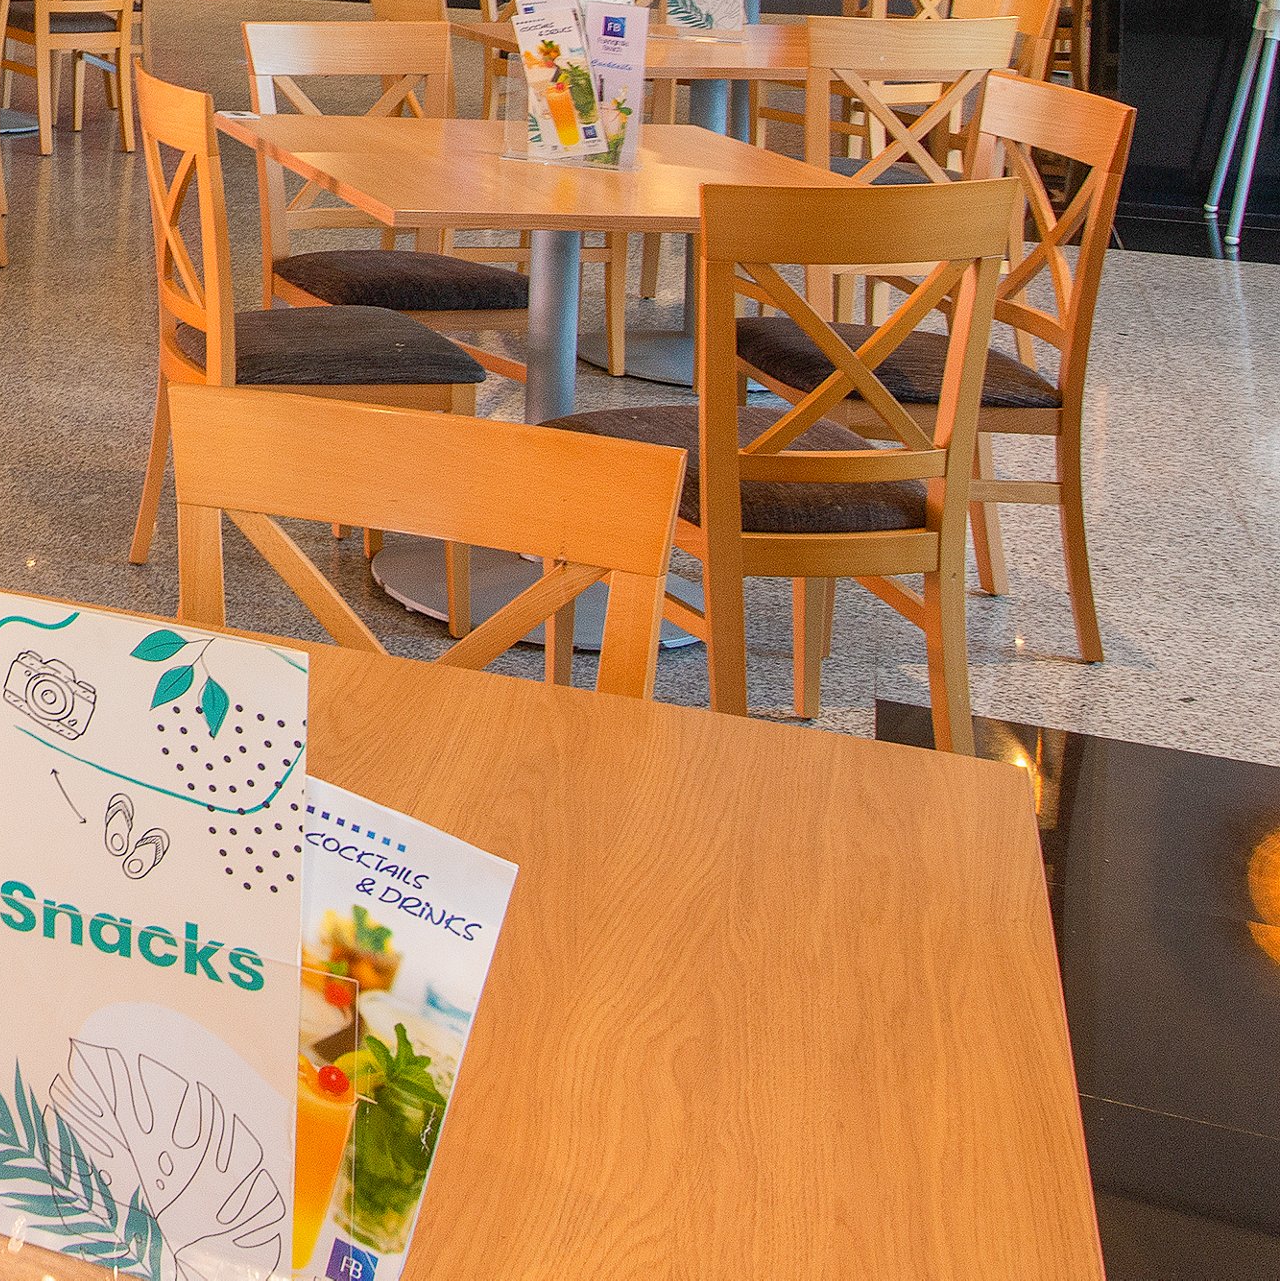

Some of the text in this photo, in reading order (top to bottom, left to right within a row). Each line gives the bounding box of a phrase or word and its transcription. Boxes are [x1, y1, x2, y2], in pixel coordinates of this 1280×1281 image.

[305, 832, 430, 890] COCKTAILS
[356, 877, 377, 896] &
[0, 880, 265, 992] Snacks
[340, 1255, 363, 1280] FB
